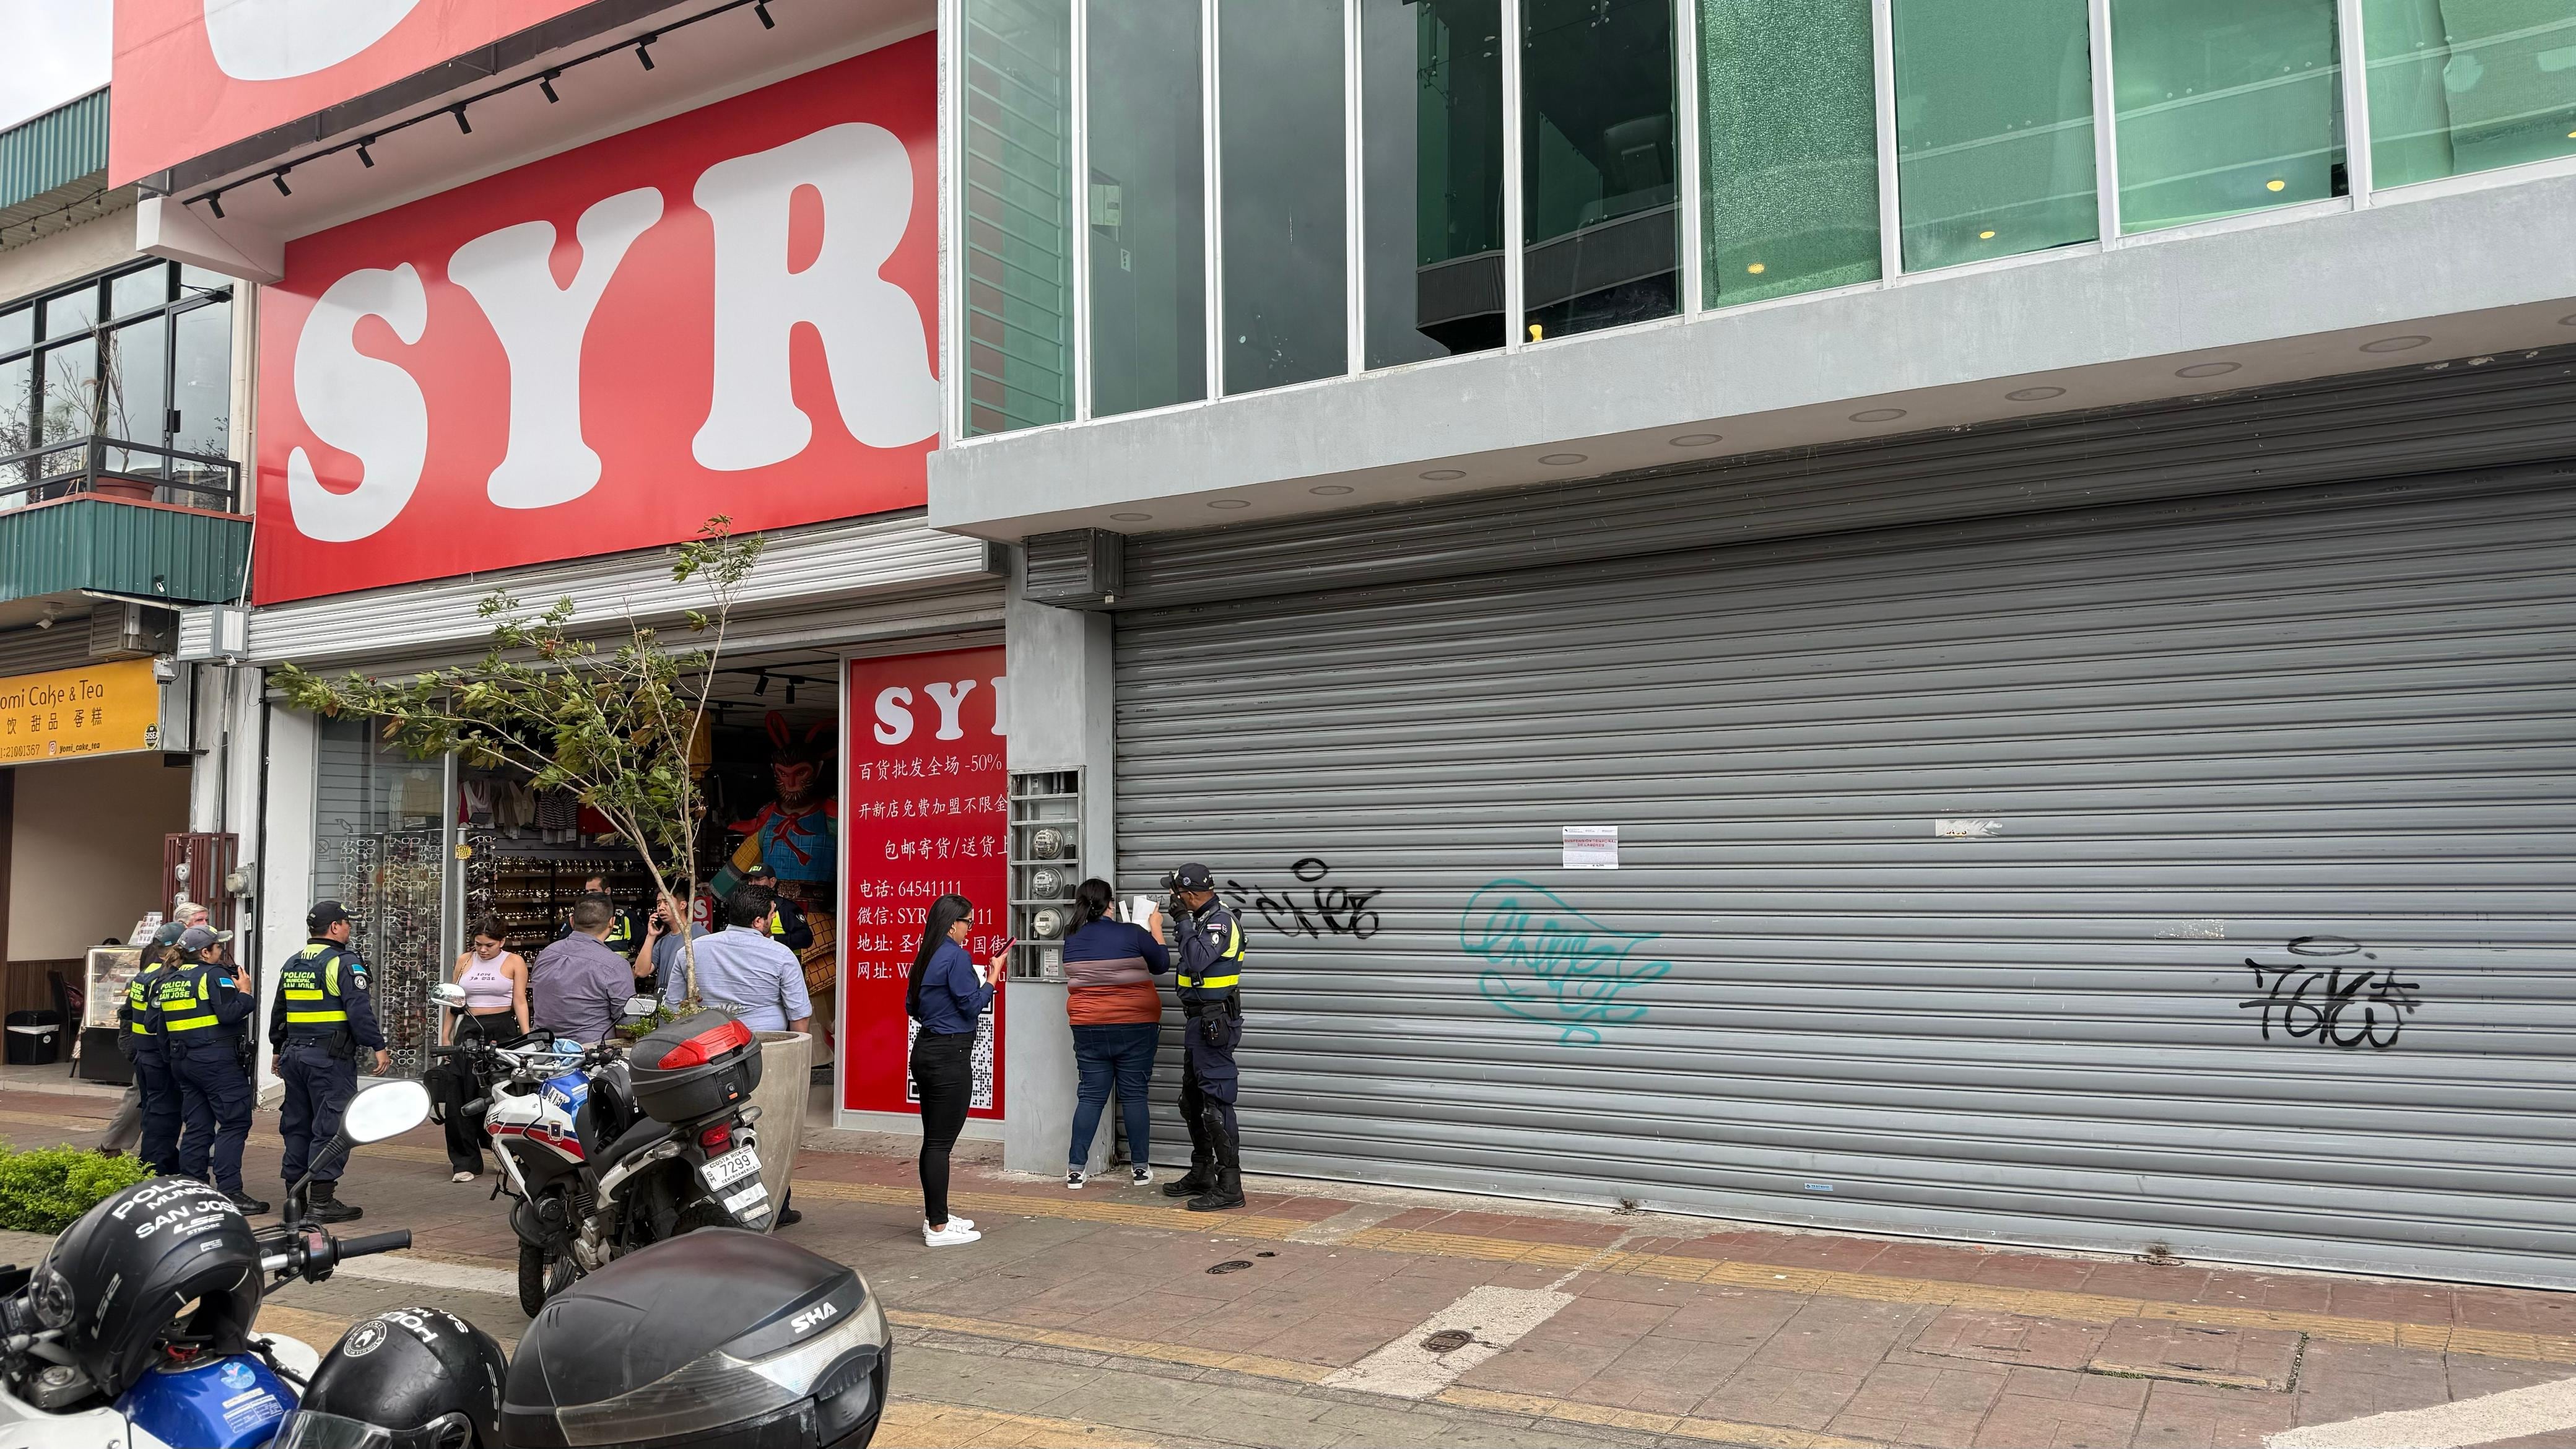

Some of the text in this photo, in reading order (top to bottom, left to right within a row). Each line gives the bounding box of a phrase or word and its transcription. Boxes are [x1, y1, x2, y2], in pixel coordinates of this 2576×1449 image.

[288, 121, 939, 542] SYR
[29, 684, 64, 708] Cake
[69, 687, 76, 701] &
[79, 679, 103, 700] Tea
[858, 754, 1002, 781] 百货批发全场 -50%
[899, 881, 961, 896] 64541111
[160, 980, 191, 990] POLICIA
[720, 1155, 751, 1177] 7299
[721, 1165, 755, 1183] CENTROAMERICA
[136, 1206, 190, 1238] SAN
[186, 1222, 221, 1236] STROBE
